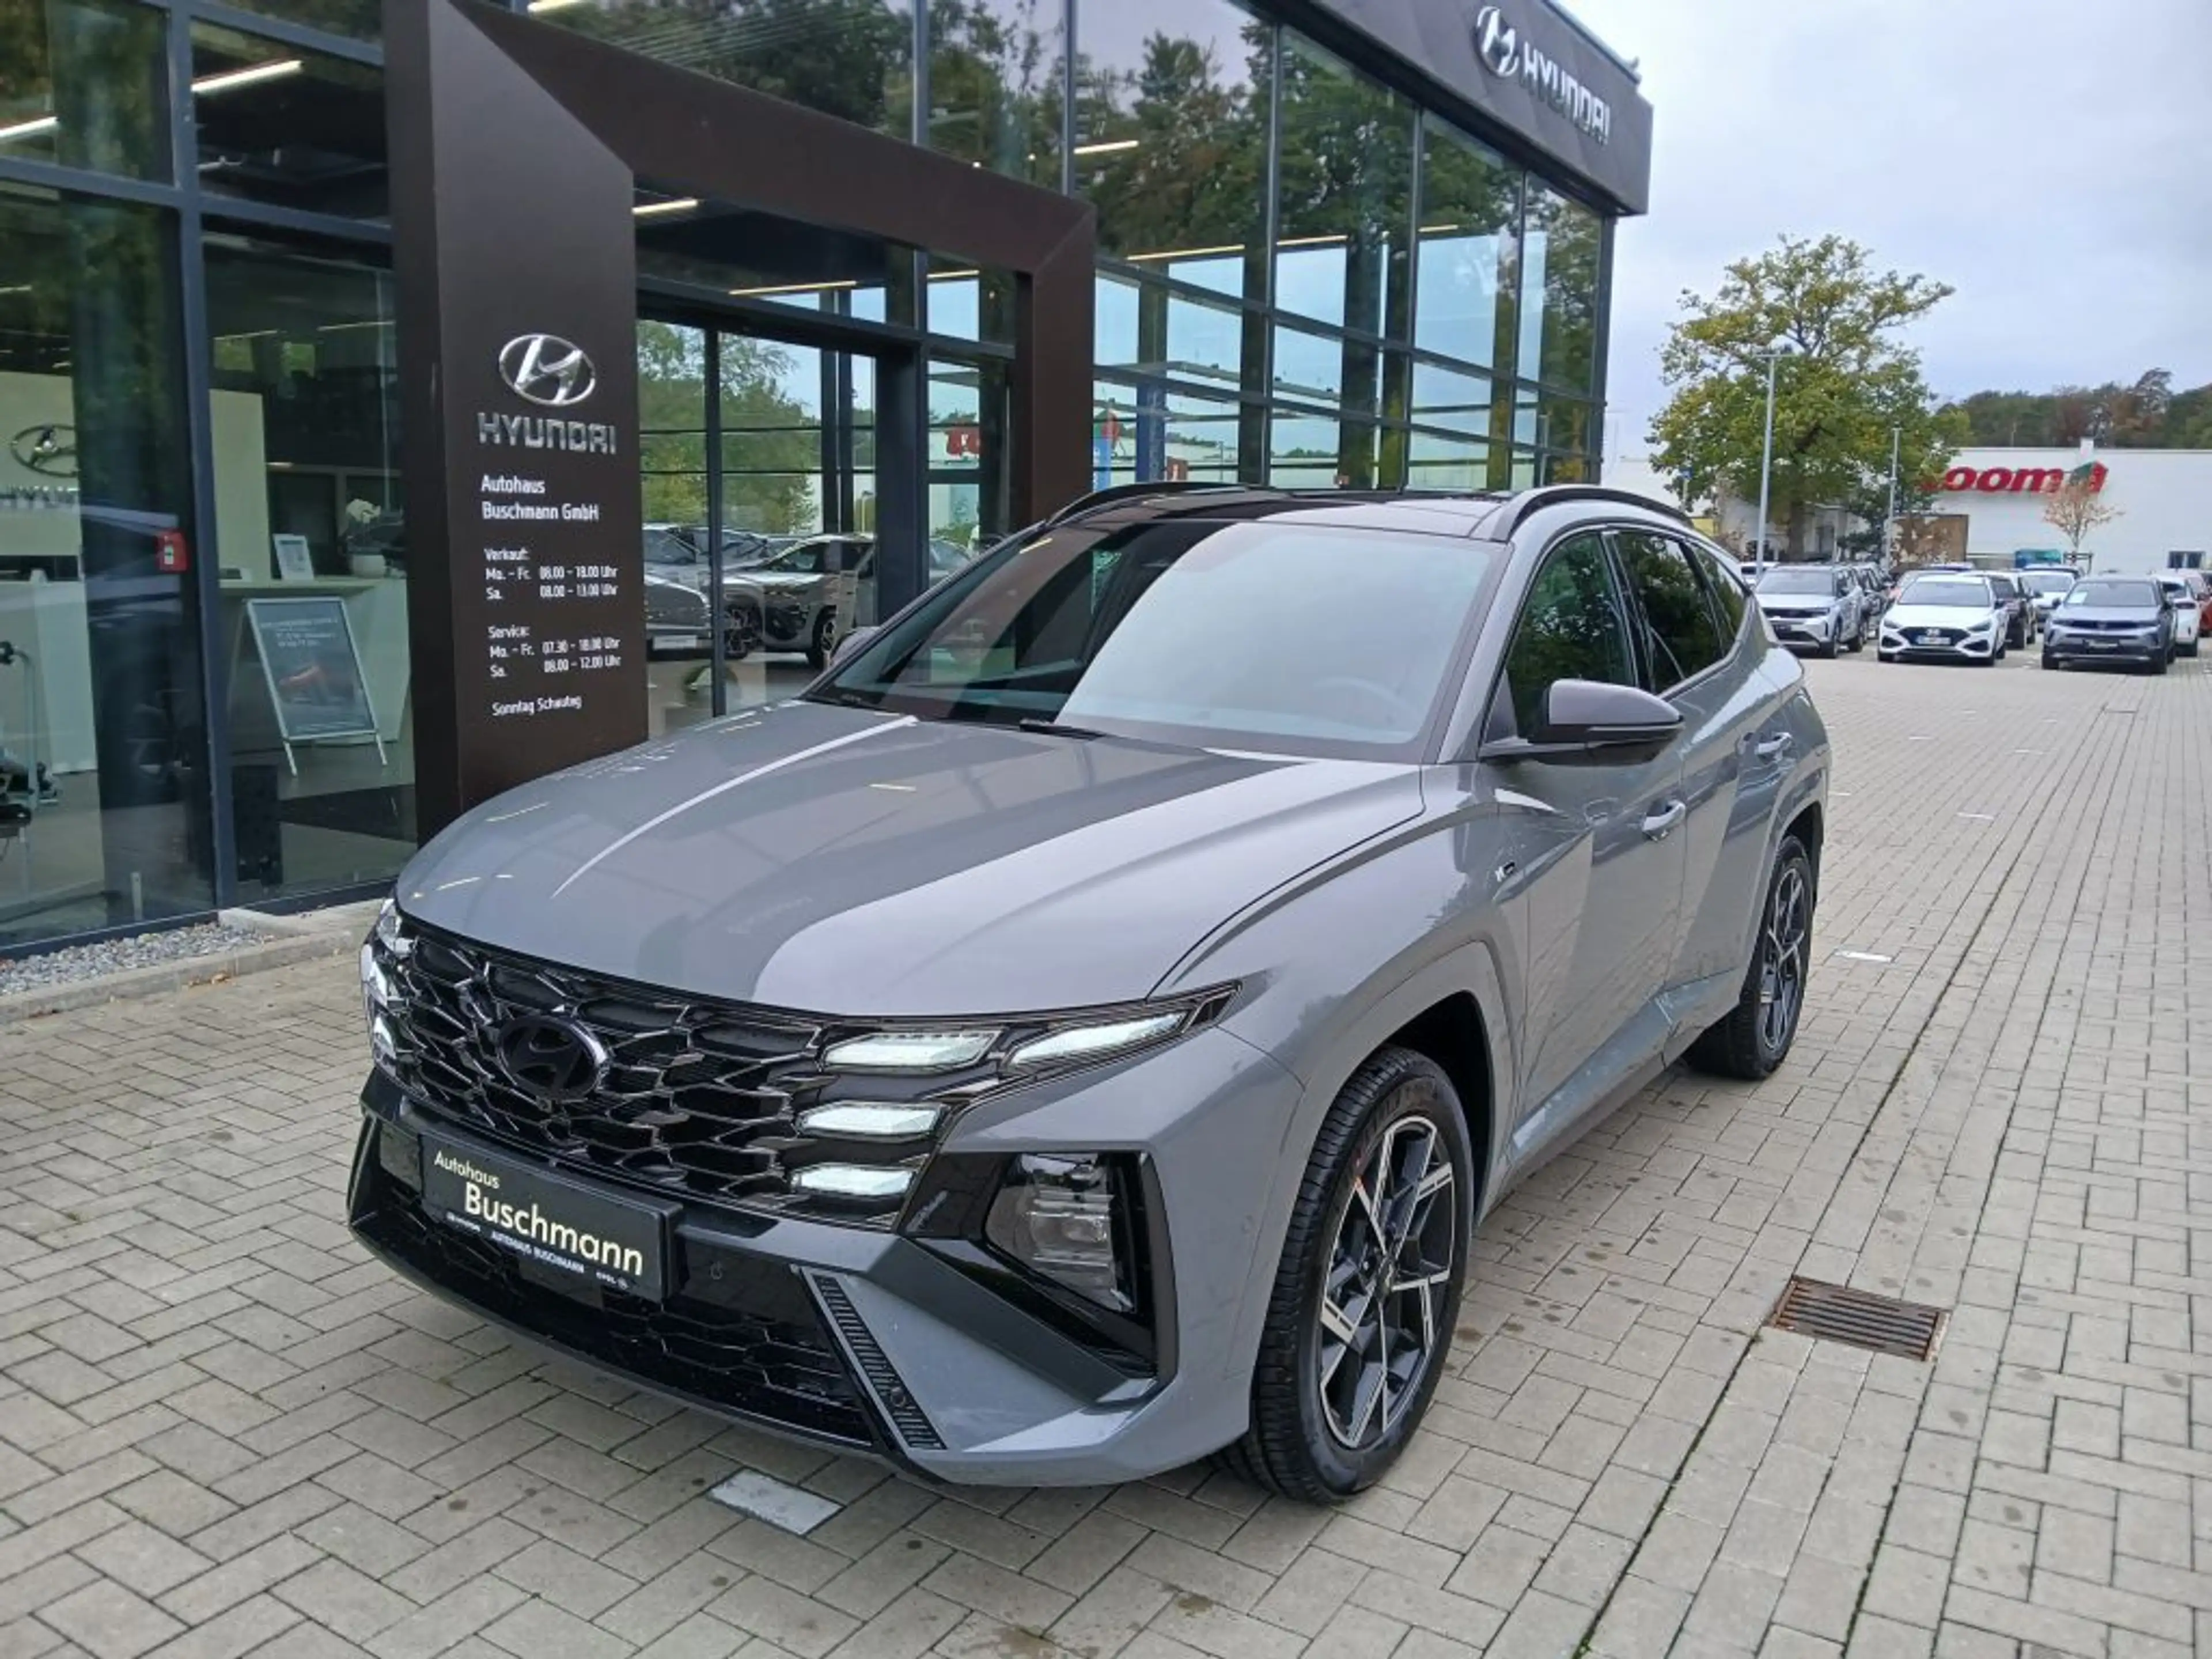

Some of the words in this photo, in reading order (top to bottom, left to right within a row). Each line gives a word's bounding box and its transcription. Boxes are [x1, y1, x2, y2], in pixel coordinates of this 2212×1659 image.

[1524, 41, 1611, 144] HYUNDAI
[478, 412, 616, 454] HYUNDAI
[481, 474, 546, 494] Autohaus
[1919, 465, 2064, 493] oom
[482, 501, 559, 519] Buschmann
[562, 503, 599, 522] GmbH
[600, 566, 619, 578] Uhr
[520, 643, 535, 656] Fr.
[492, 700, 535, 716] Sonntag
[434, 1150, 500, 1190] Autohaus
[464, 1181, 643, 1277] Buschmann
